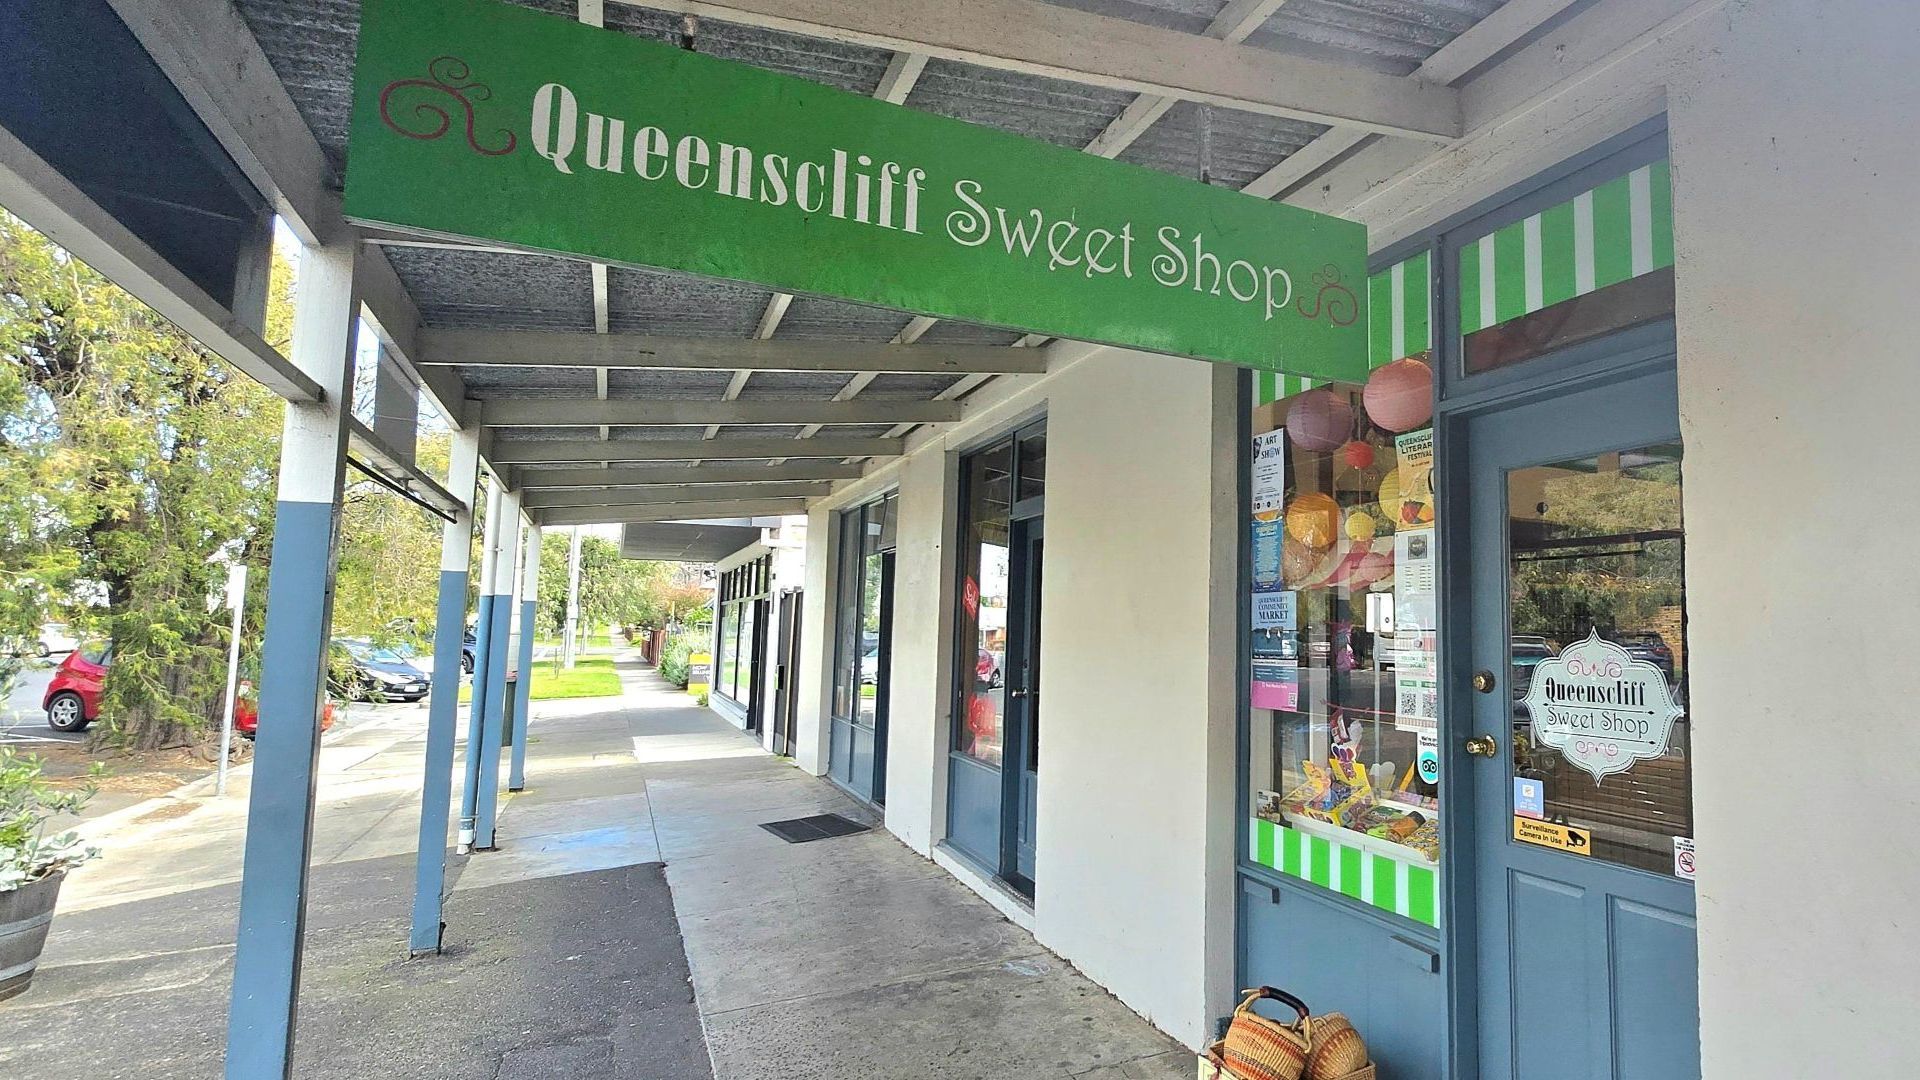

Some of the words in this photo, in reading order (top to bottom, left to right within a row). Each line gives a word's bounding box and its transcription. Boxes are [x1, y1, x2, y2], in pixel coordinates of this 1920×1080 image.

[530, 82, 927, 236] Queenscliff
[945, 179, 1136, 280] Sweet
[1150, 225, 1293, 322] Shop
[1264, 434, 1277, 446] ART
[1258, 610, 1289, 620] MARKET
[1545, 676, 1647, 706] Queenscliff
[1547, 706, 1595, 730] Sweet
[1600, 710, 1649, 739] Shop
[1521, 821, 1559, 836] Surveillance
[1518, 829, 1542, 840] Camera
[1550, 835, 1563, 845] Use
